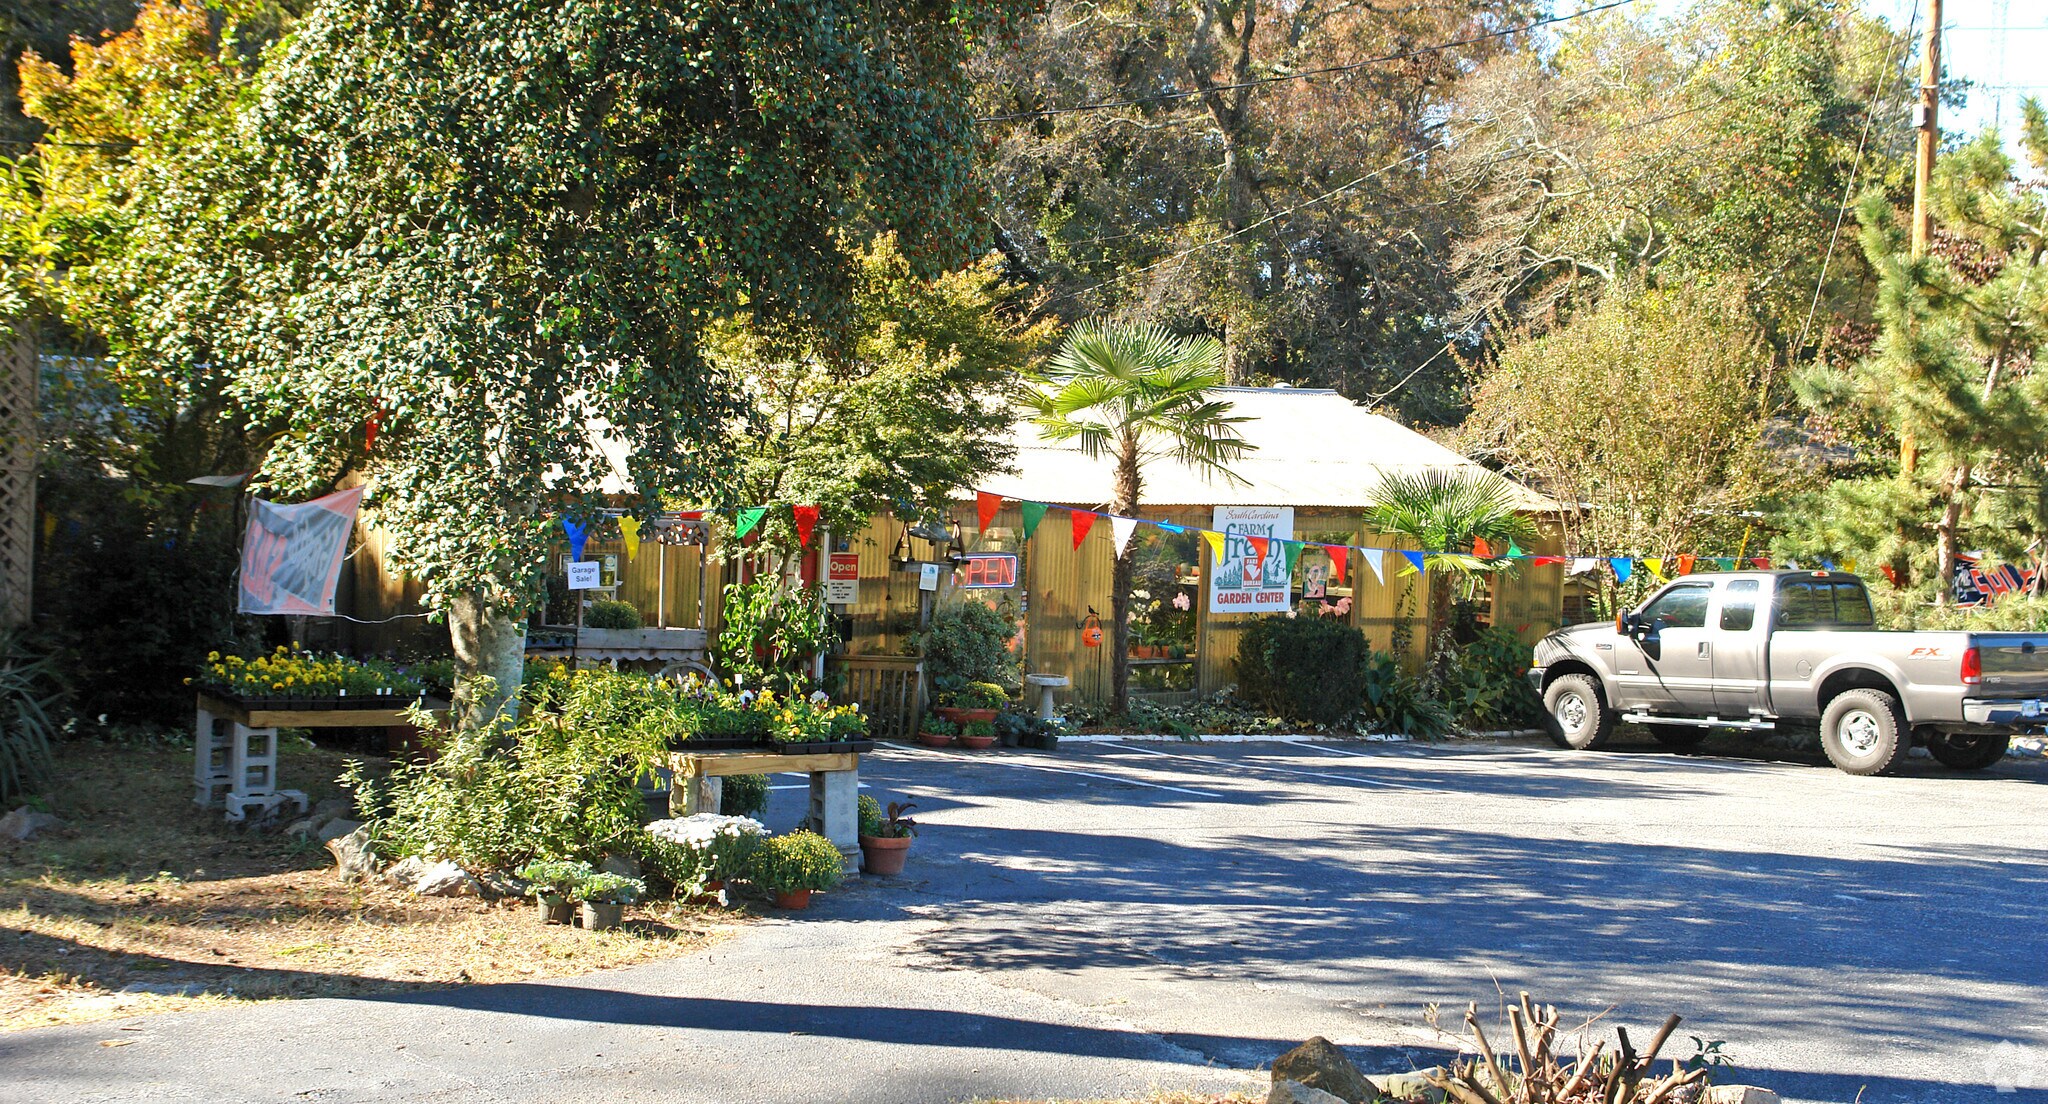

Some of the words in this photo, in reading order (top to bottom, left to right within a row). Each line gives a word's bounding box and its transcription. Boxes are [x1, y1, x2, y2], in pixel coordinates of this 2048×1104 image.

[1238, 523, 1266, 535] FARM
[1222, 523, 1281, 567] freh
[571, 566, 596, 575] Garage
[830, 561, 857, 573] Open
[575, 575, 592, 583] Sale!
[1217, 592, 1252, 605] GARDEN
[1255, 591, 1285, 604] CENTER
